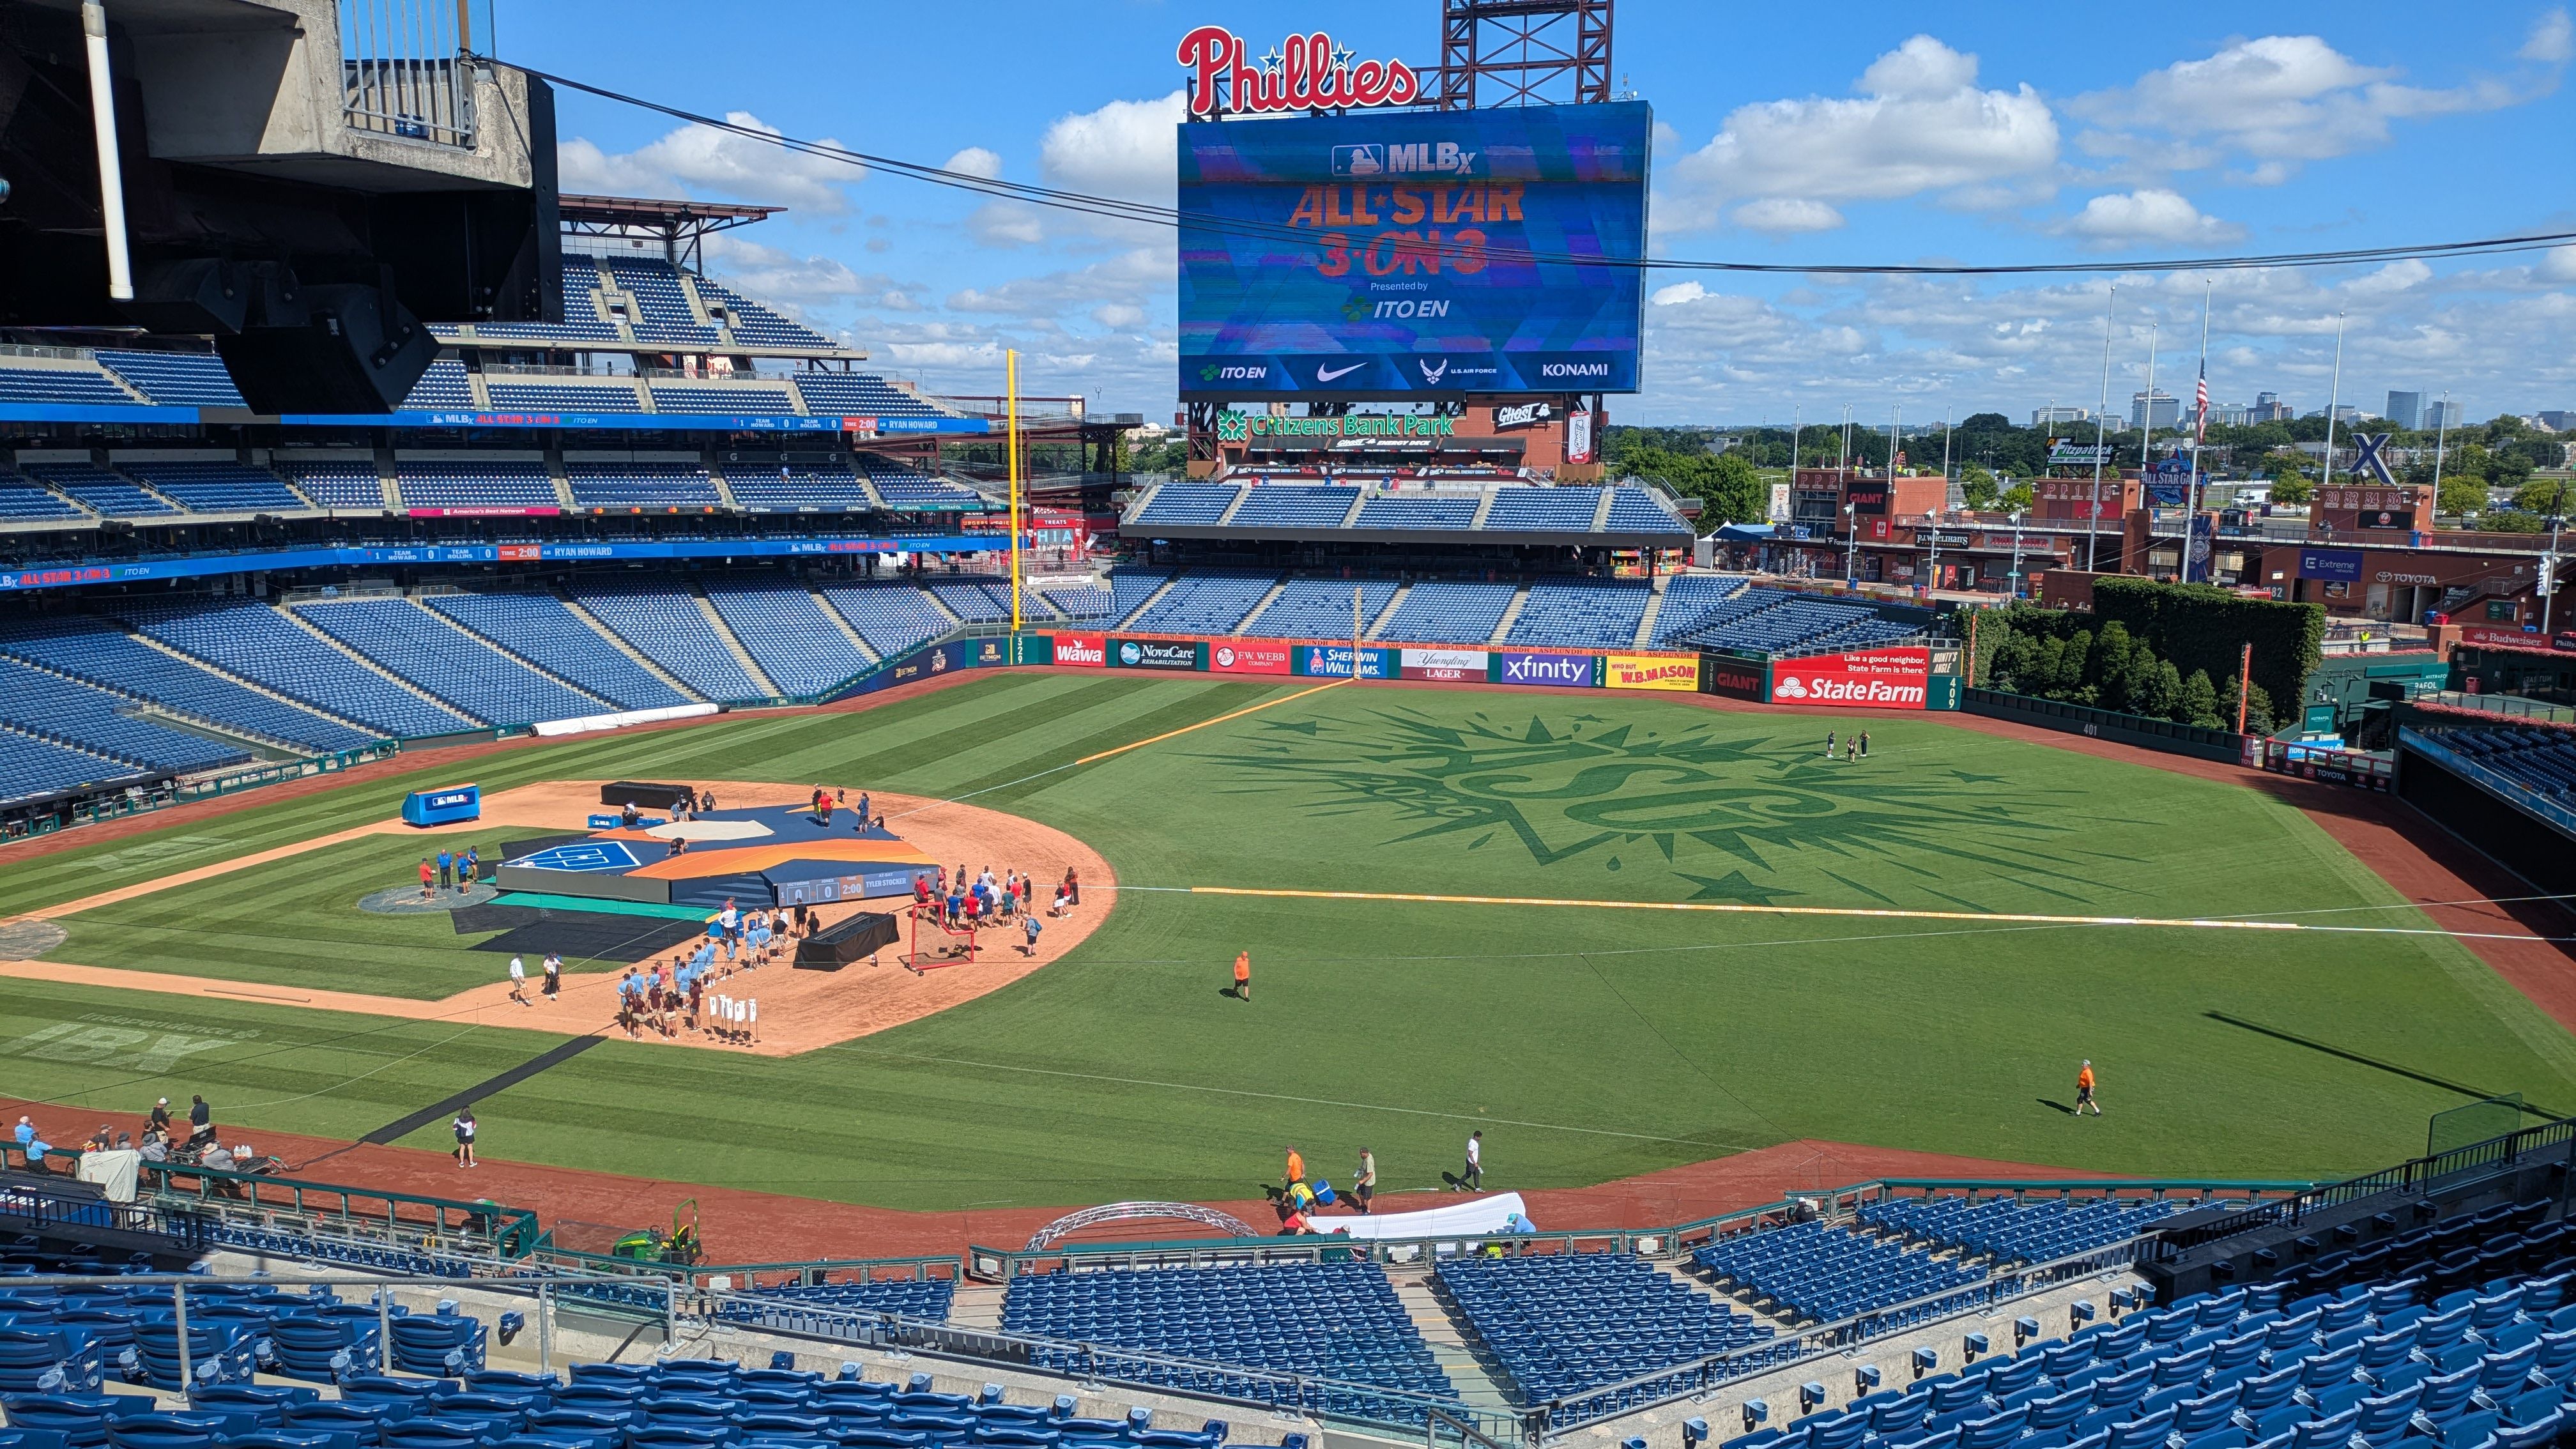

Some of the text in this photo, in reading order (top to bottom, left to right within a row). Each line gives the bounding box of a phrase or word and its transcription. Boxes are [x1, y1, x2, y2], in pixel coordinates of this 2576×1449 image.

[1177, 25, 1418, 116] Phillies
[1370, 282, 1428, 292] Presented by
[1374, 300, 1450, 318] ITO EN
[1220, 367, 1267, 378] ITO EN
[1542, 364, 1608, 376] KONAMI
[1498, 402, 1540, 427] GHOST
[784, 419, 789, 428] 0
[831, 420, 836, 429] 0
[859, 420, 875, 429] 2:00
[889, 420, 907, 429] RYAN
[908, 420, 937, 429] HOWARD
[1252, 413, 1455, 436] Citizens Bank Park
[2142, 472, 2157, 484] ALL
[2159, 472, 2179, 485] STAR
[1850, 493, 1883, 503] GIANT
[2326, 491, 2340, 504] 20
[2343, 492, 2359, 504] 32
[2365, 492, 2380, 505] 34
[2386, 493, 2401, 505] 36
[428, 549, 434, 560] 0
[485, 549, 491, 558] 0
[518, 548, 538, 558] 2:00
[555, 548, 576, 556] RYAN
[578, 547, 612, 556] HOWARD
[2319, 560, 2355, 569] Extreme
[2394, 574, 2437, 585] TOYOTA
[1057, 646, 1103, 663] Wawa
[1141, 645, 1194, 659] NovaCare
[1238, 650, 1285, 661] F.W. WEBB
[1932, 652, 1958, 663] MONTY'S
[1417, 652, 1472, 667] Yuengling
[1844, 654, 1860, 663] Like
[1869, 656, 1888, 665] good
[1890, 656, 1926, 665] neighbor,
[1426, 669, 1461, 678] LAGER
[1506, 656, 1586, 682] xfinity
[1933, 663, 1951, 674] ANGLE
[1717, 670, 1759, 691] GIANT
[2084, 724, 2097, 735] 401
[2317, 769, 2346, 781] TOYOTA
[882, 878, 906, 886] STOCKER
[824, 886, 832, 898] 0
[842, 883, 861, 894] 2:00
[78, 1013, 232, 1036] Independence
